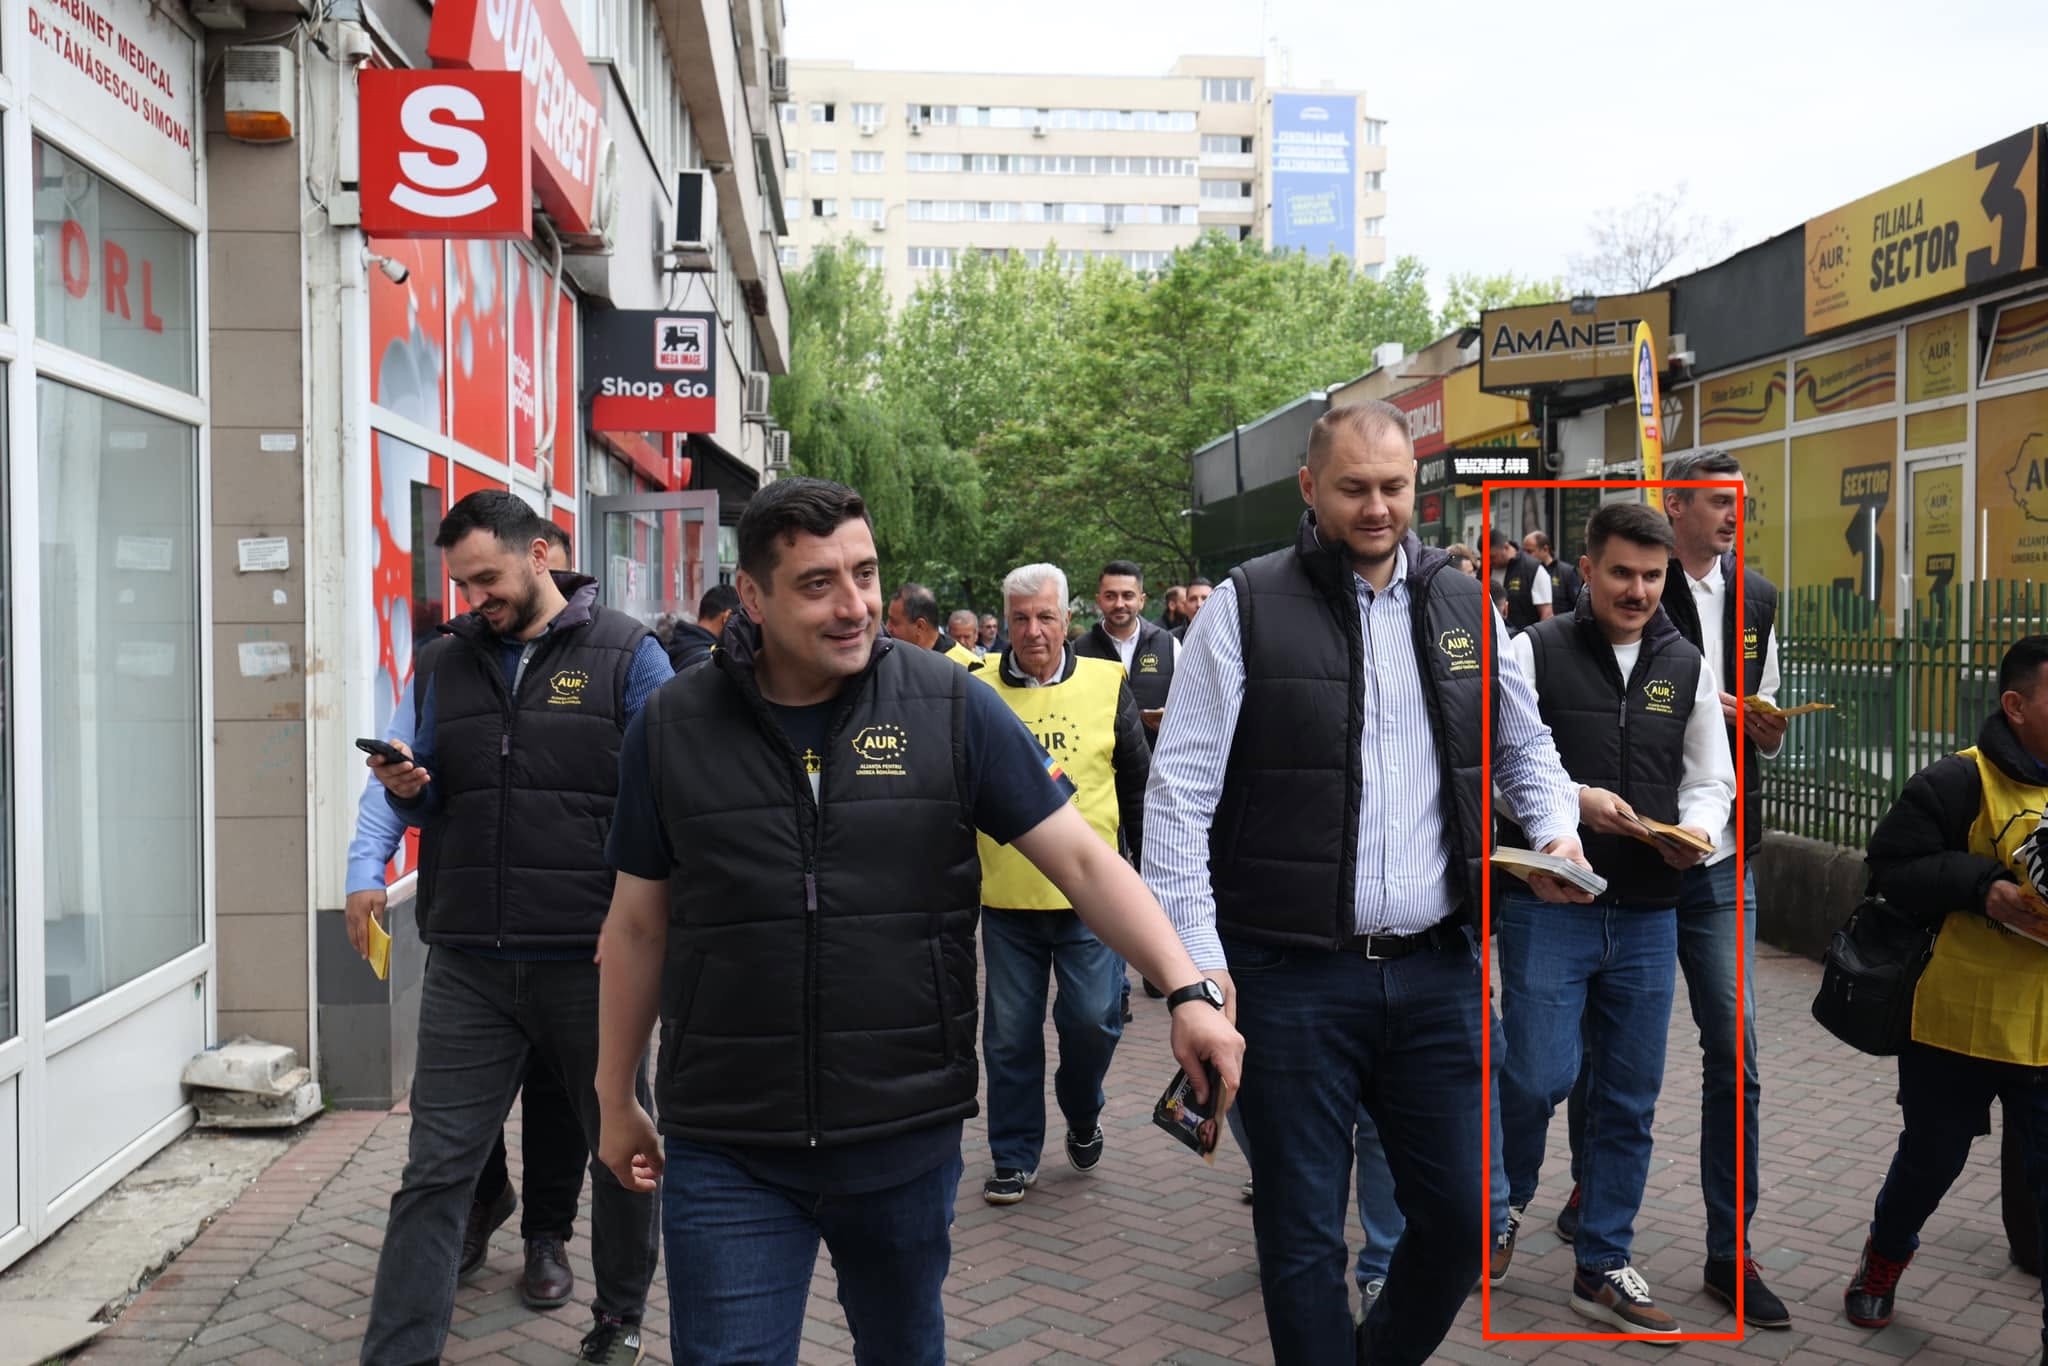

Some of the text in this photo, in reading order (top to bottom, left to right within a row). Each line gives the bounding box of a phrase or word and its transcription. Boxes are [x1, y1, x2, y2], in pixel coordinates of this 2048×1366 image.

[48, 0, 174, 98] ABINET MEDICAL
[28, 7, 48, 45] Dr.
[143, 97, 191, 152] SIMONA
[398, 84, 488, 190] S
[1870, 127, 2034, 292] SECTOR 3
[1873, 197, 1924, 243] FILIALA
[1818, 245, 1844, 272] AUR
[60, 219, 163, 334] ORL
[1928, 341, 1951, 360] AUR
[1844, 469, 1889, 497] SECTOR
[1448, 637, 1470, 649] AUR
[558, 677, 582, 688] AUR
[1651, 686, 1670, 697] AUR
[864, 736, 898, 749] AUR
[1035, 732, 1066, 749] UR
